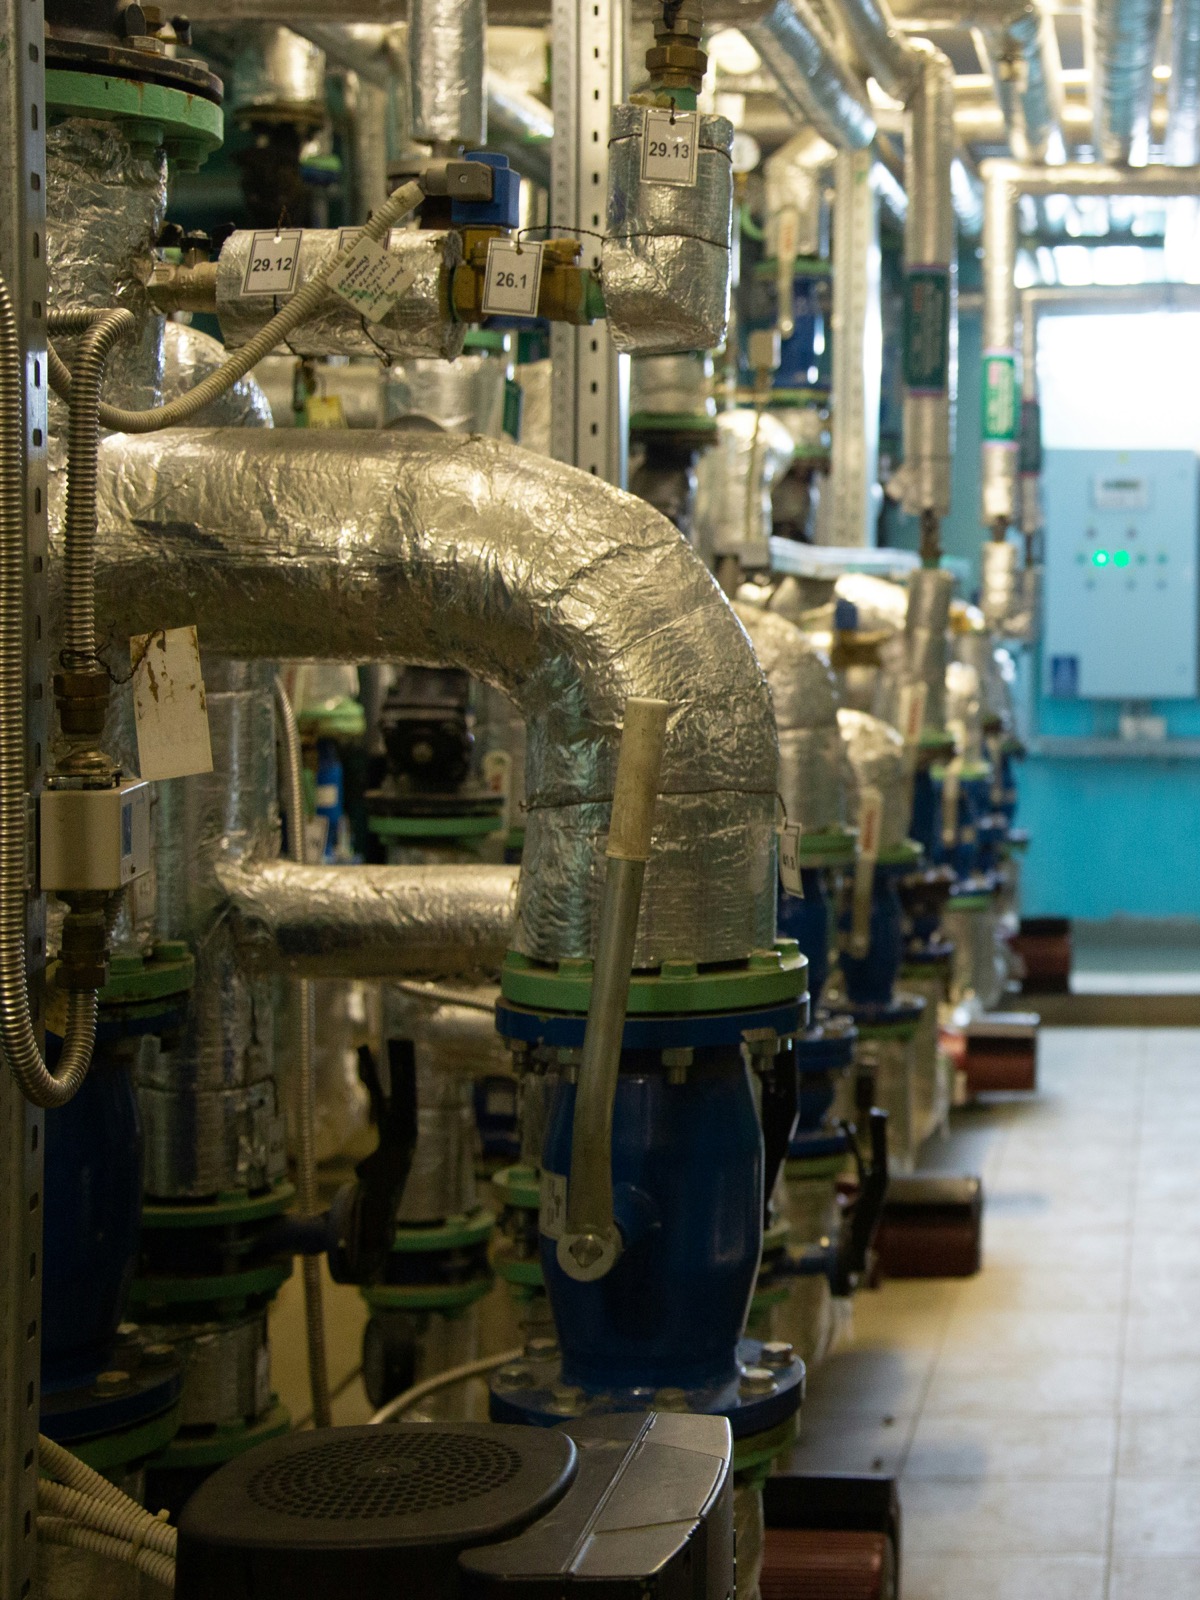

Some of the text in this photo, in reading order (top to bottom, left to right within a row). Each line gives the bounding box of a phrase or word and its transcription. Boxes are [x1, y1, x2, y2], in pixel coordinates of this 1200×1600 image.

[648, 141, 690, 159] 29.13
[252, 256, 293, 272] 29.12
[495, 271, 528, 289] 26.1
